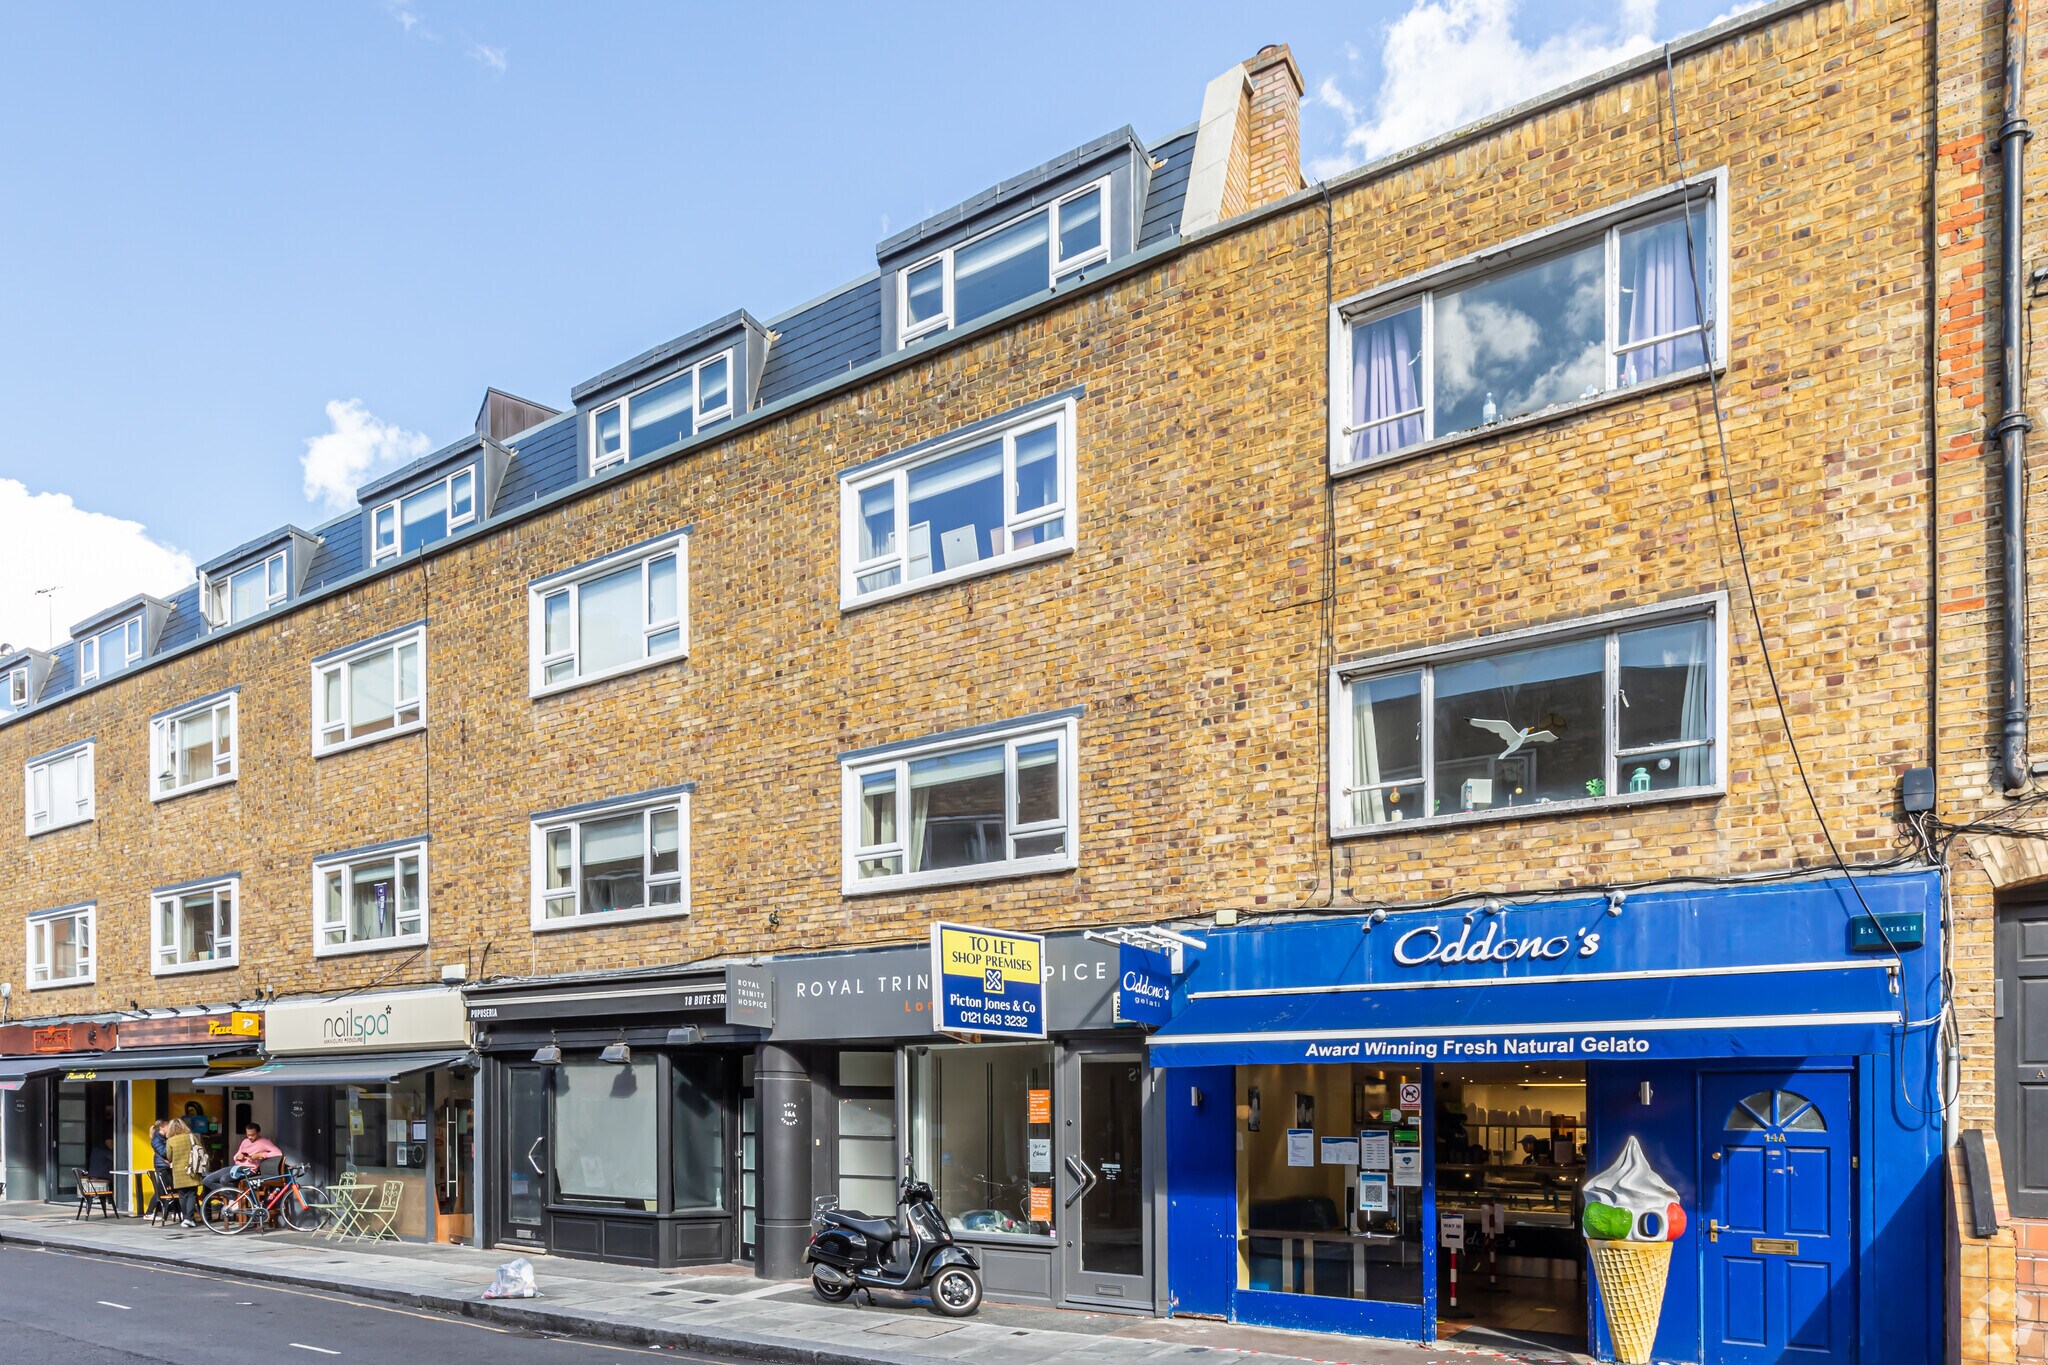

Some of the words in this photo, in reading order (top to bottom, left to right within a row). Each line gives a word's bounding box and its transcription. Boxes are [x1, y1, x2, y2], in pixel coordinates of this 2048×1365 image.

[1860, 925, 1917, 934] EUOTECH
[969, 936, 988, 952] TO
[994, 940, 1015, 955] LET
[1394, 921, 1600, 964] Oddono's
[952, 951, 981, 965] SHOP
[986, 955, 1032, 971] PREMISES
[737, 979, 760, 989] ROYAL
[797, 978, 864, 998] ROYAL
[878, 974, 929, 992] TRIN
[1045, 962, 1106, 982] PICE
[1123, 971, 1170, 1000] Oddono's
[684, 995, 693, 1006] 18
[694, 994, 711, 1006] BUTE
[737, 989, 764, 999] TRINITY
[950, 993, 981, 1008] Picton
[984, 997, 1010, 1011] Jones
[1012, 1000, 1020, 1011] &
[1022, 1001, 1036, 1013] Co
[1134, 996, 1160, 1008] gelati
[738, 998, 767, 1009] HOSPICE
[323, 1007, 389, 1045] nailspa
[960, 1011, 981, 1023] 0121
[983, 1013, 1002, 1025] 643
[1004, 1015, 1028, 1028] 3232
[1305, 1042, 1360, 1057] Award
[1364, 1041, 1438, 1059] Winning
[1443, 1039, 1498, 1055] Fresh
[1503, 1037, 1575, 1055] Natural
[1580, 1036, 1650, 1053] Gelato
[1763, 1133, 1787, 1143] 14A
